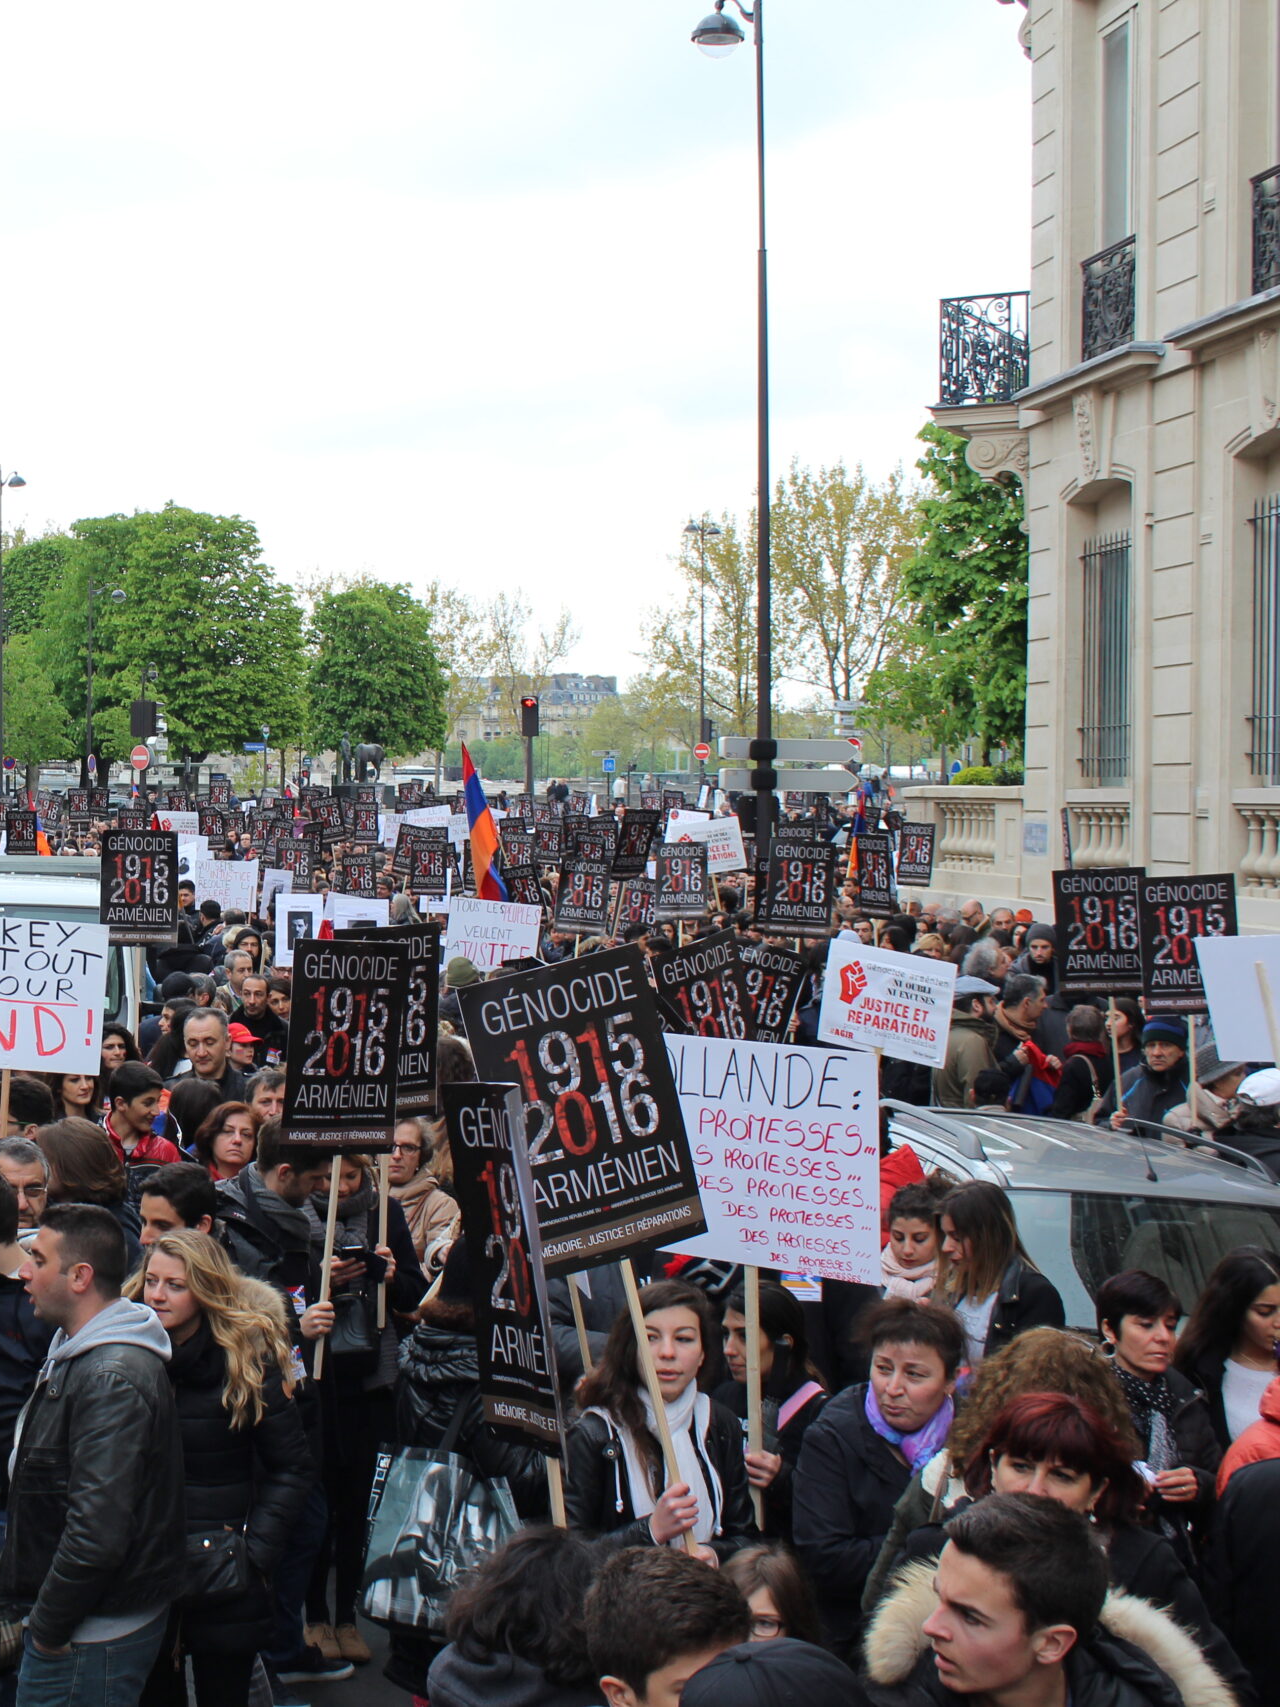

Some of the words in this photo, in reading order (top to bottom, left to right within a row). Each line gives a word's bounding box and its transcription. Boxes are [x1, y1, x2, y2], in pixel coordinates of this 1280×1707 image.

[357, 810, 376, 822] 1915
[357, 819, 376, 830] 2016
[107, 834, 172, 852] GÉNOCIDE
[660, 846, 704, 857] GÉNOCIDE
[775, 845, 831, 859] GÉNOCIDE
[905, 836, 931, 850] 1915
[281, 850, 309, 863] 1915
[415, 851, 443, 865] 1915
[862, 852, 887, 870] 1915
[901, 849, 930, 864] 2016
[112, 853, 169, 880] 1915
[346, 865, 372, 879] 1915
[414, 863, 443, 876] 2016
[564, 860, 608, 874] GÉNOCIDE
[665, 858, 702, 876] 1915
[779, 859, 826, 883] 1915
[346, 877, 373, 890] 2016
[567, 873, 604, 891] 1915
[661, 874, 702, 892] 2016
[861, 869, 887, 889] 2016
[1060, 874, 1138, 893] GÉNOCIDE
[109, 878, 169, 905] 2016
[562, 888, 602, 908] 2016
[660, 892, 704, 904] ARMÉNIEN
[775, 880, 826, 904] 2016
[1145, 882, 1228, 904] GÉNOCIDE
[106, 905, 172, 922] ARMÉNIEN
[453, 899, 481, 913] TOUS
[486, 901, 505, 914] LES
[560, 905, 604, 920] ARMÉNIEN
[771, 903, 827, 919] ARMÉNIEN
[1070, 895, 1137, 926] 1915
[1153, 903, 1226, 937] 1915
[464, 925, 513, 940] VEULENT
[1067, 922, 1139, 951] 2016
[1152, 934, 1193, 965] 20
[24, 949, 103, 976] OUT
[304, 949, 399, 981] GÉNOCIDE
[662, 941, 736, 985] GÉNOCIDE
[1066, 952, 1142, 970] ARMÉNIEN
[675, 968, 739, 1024] 1915
[893, 979, 902, 988] NI
[905, 980, 932, 995] OUBLI
[480, 966, 638, 1036] GÉNOCIDE
[887, 988, 896, 997] NI
[899, 991, 935, 1005] EXCUSES
[309, 986, 390, 1033] 1915
[859, 997, 910, 1019] JUSTICE
[913, 1008, 929, 1023] ET
[847, 1009, 936, 1042] REPARATIONS
[302, 1028, 386, 1078] 2016
[503, 1011, 645, 1102] 1915
[294, 1080, 388, 1109] ARMÉNIEN
[522, 1069, 659, 1166] 2016
[288, 1131, 319, 1141] MÉMOIRE,
[320, 1131, 342, 1140] JUSTICE
[349, 1130, 387, 1139] RÉPARATIONS
[532, 1140, 681, 1212] ARMÉNIEN
[721, 1200, 759, 1219] DES
[588, 1227, 624, 1247] JUSTICE
[625, 1223, 636, 1236] ET
[637, 1205, 692, 1232] RÉPARATIONS
[739, 1228, 770, 1246] DES
[769, 1252, 789, 1264] DES
